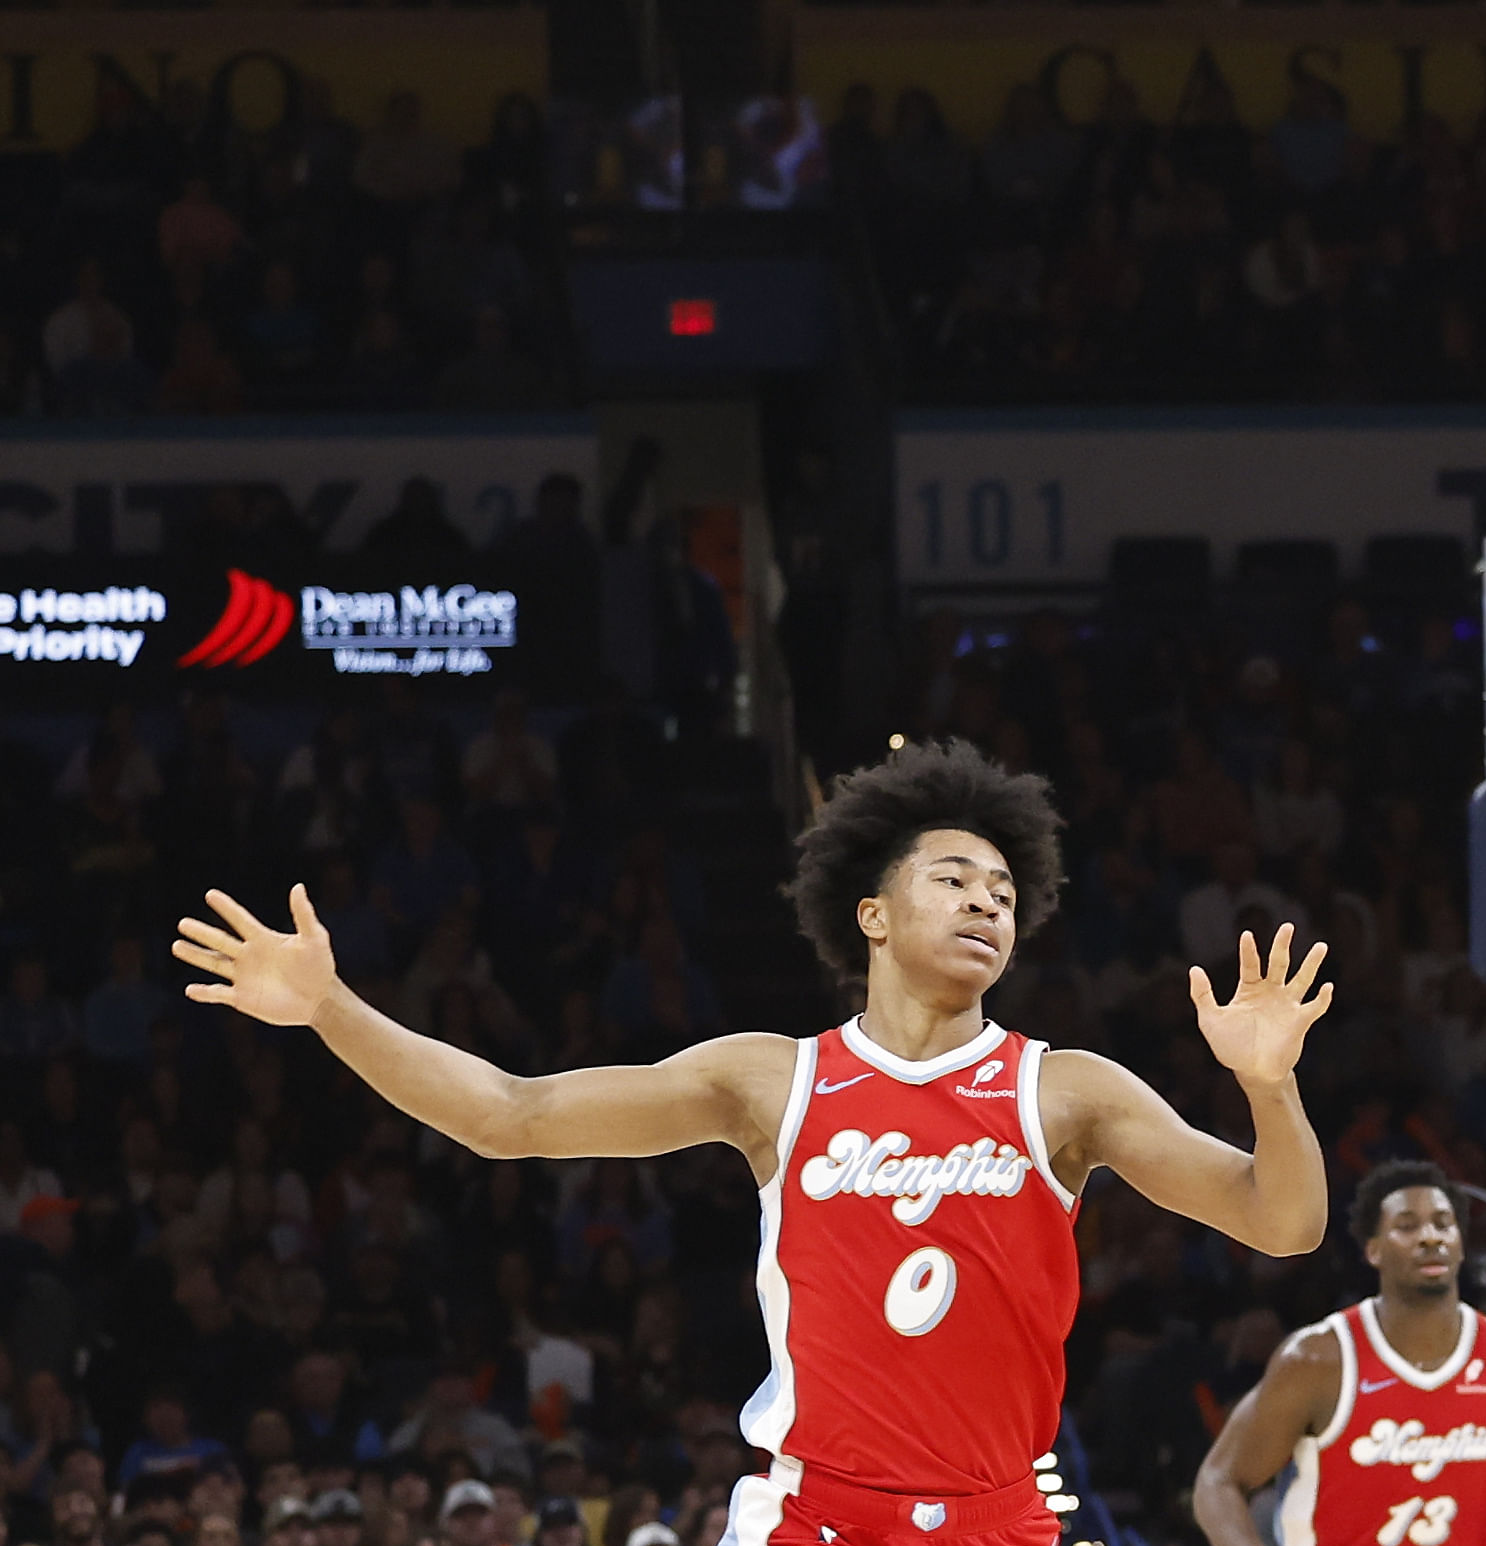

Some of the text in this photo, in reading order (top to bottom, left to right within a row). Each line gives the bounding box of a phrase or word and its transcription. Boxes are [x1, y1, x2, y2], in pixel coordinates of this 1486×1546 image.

[914, 479, 1066, 568] 101
[20, 586, 166, 624] Health
[801, 1129, 1033, 1226] Memphis
[884, 1246, 958, 1337] 0
